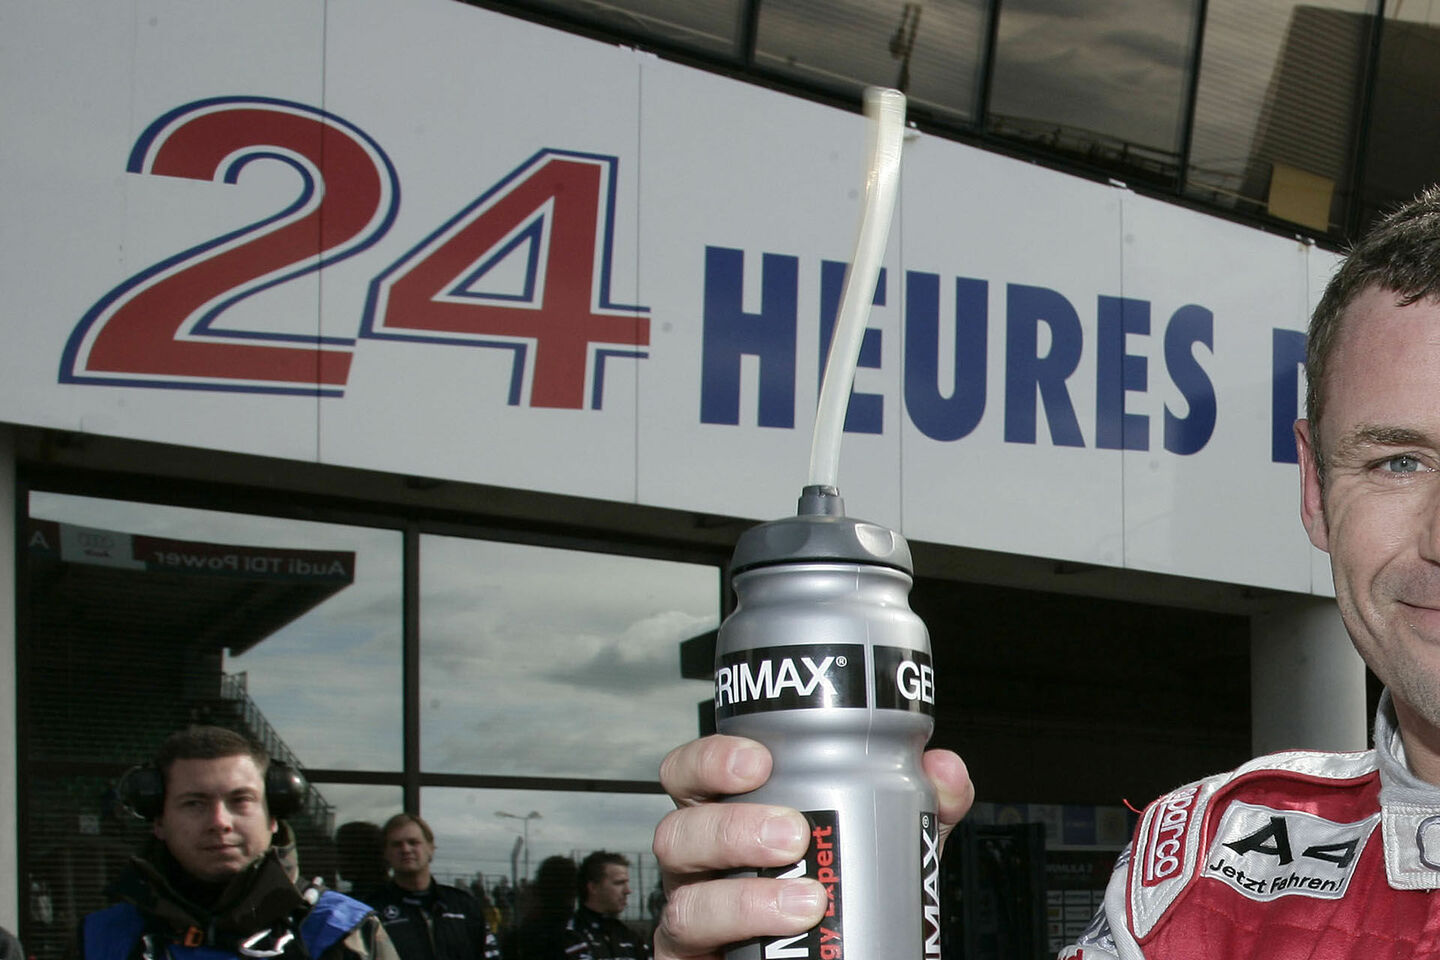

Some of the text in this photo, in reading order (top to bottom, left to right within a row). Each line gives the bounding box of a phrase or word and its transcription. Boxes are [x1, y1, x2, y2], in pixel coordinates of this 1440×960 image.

[57, 95, 651, 411] 24
[700, 246, 1218, 457] HEURES
[1222, 816, 1362, 868] A4
[1210, 859, 1345, 894] Jetzt Fahren!
